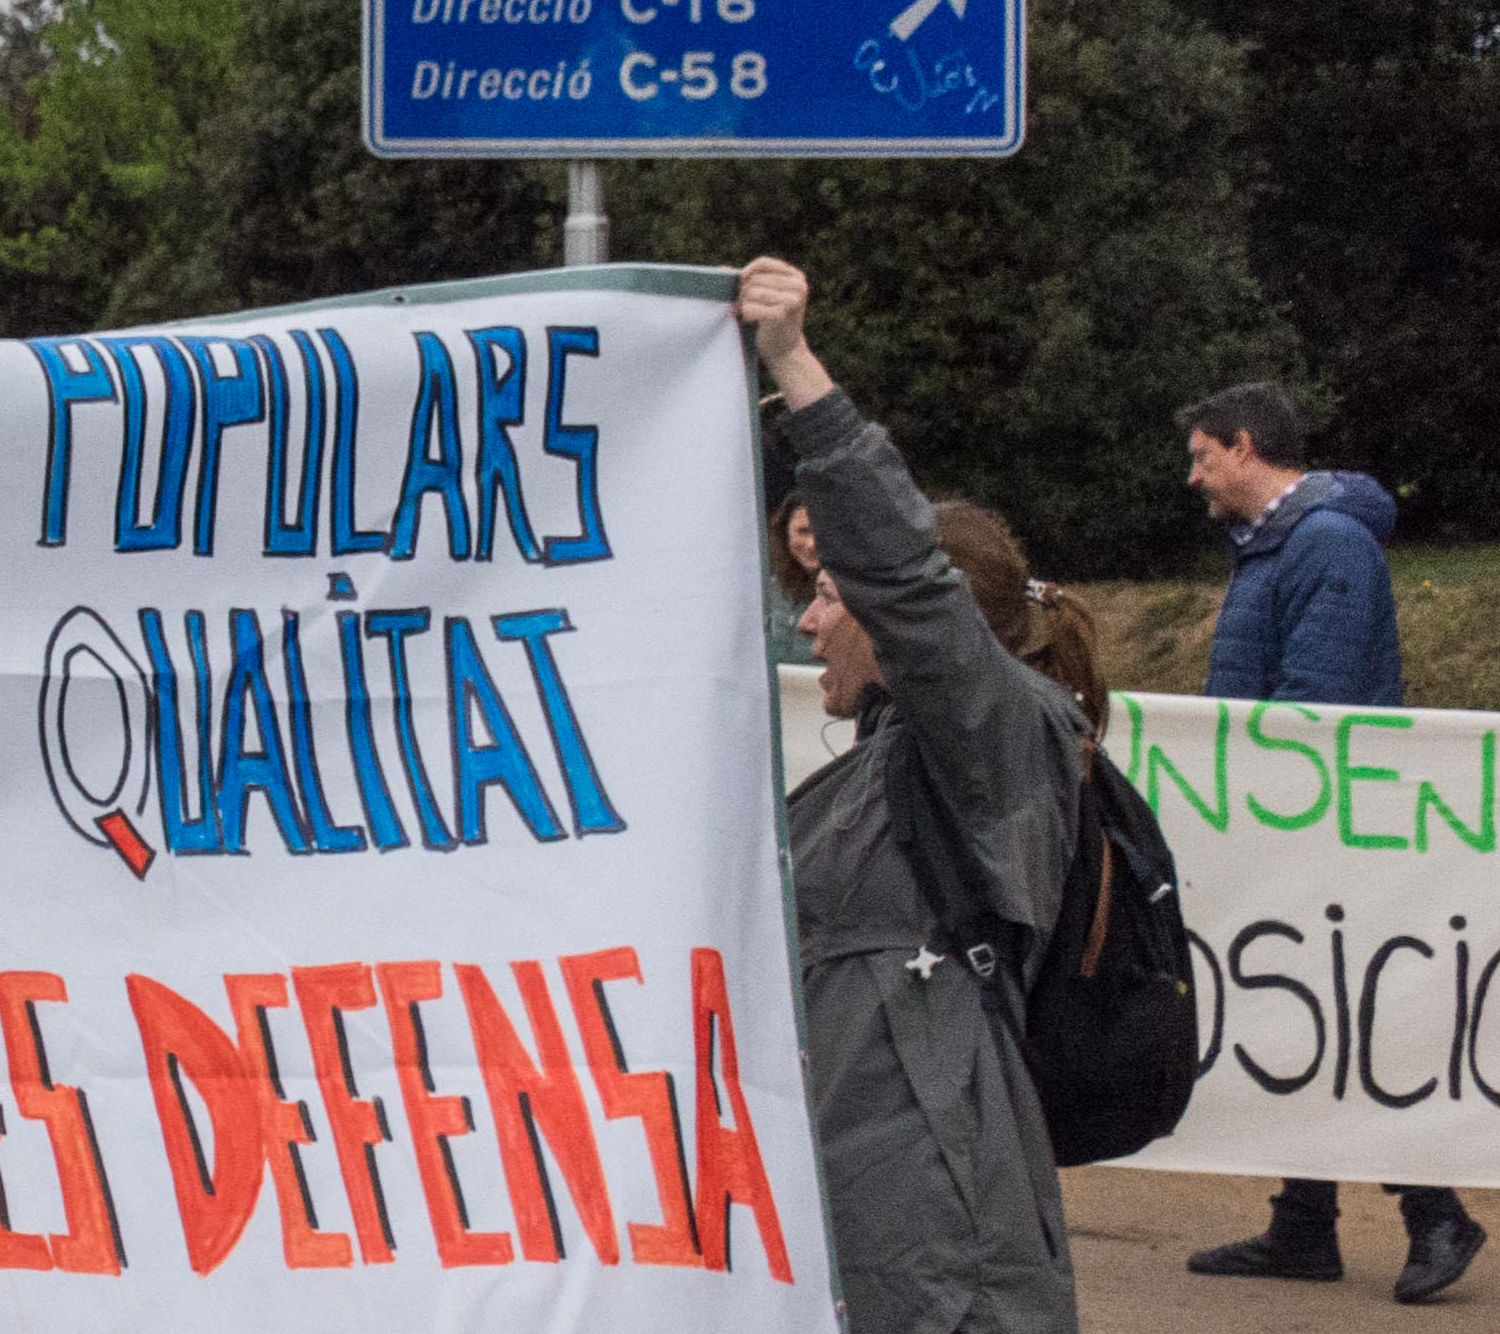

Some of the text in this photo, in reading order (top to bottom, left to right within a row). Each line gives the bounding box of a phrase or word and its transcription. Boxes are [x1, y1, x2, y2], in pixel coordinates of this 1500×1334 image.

[410, 51, 769, 100] Direcció C-58
[20, 324, 614, 567] POPULARS
[123, 945, 796, 1286] DEFENSA
